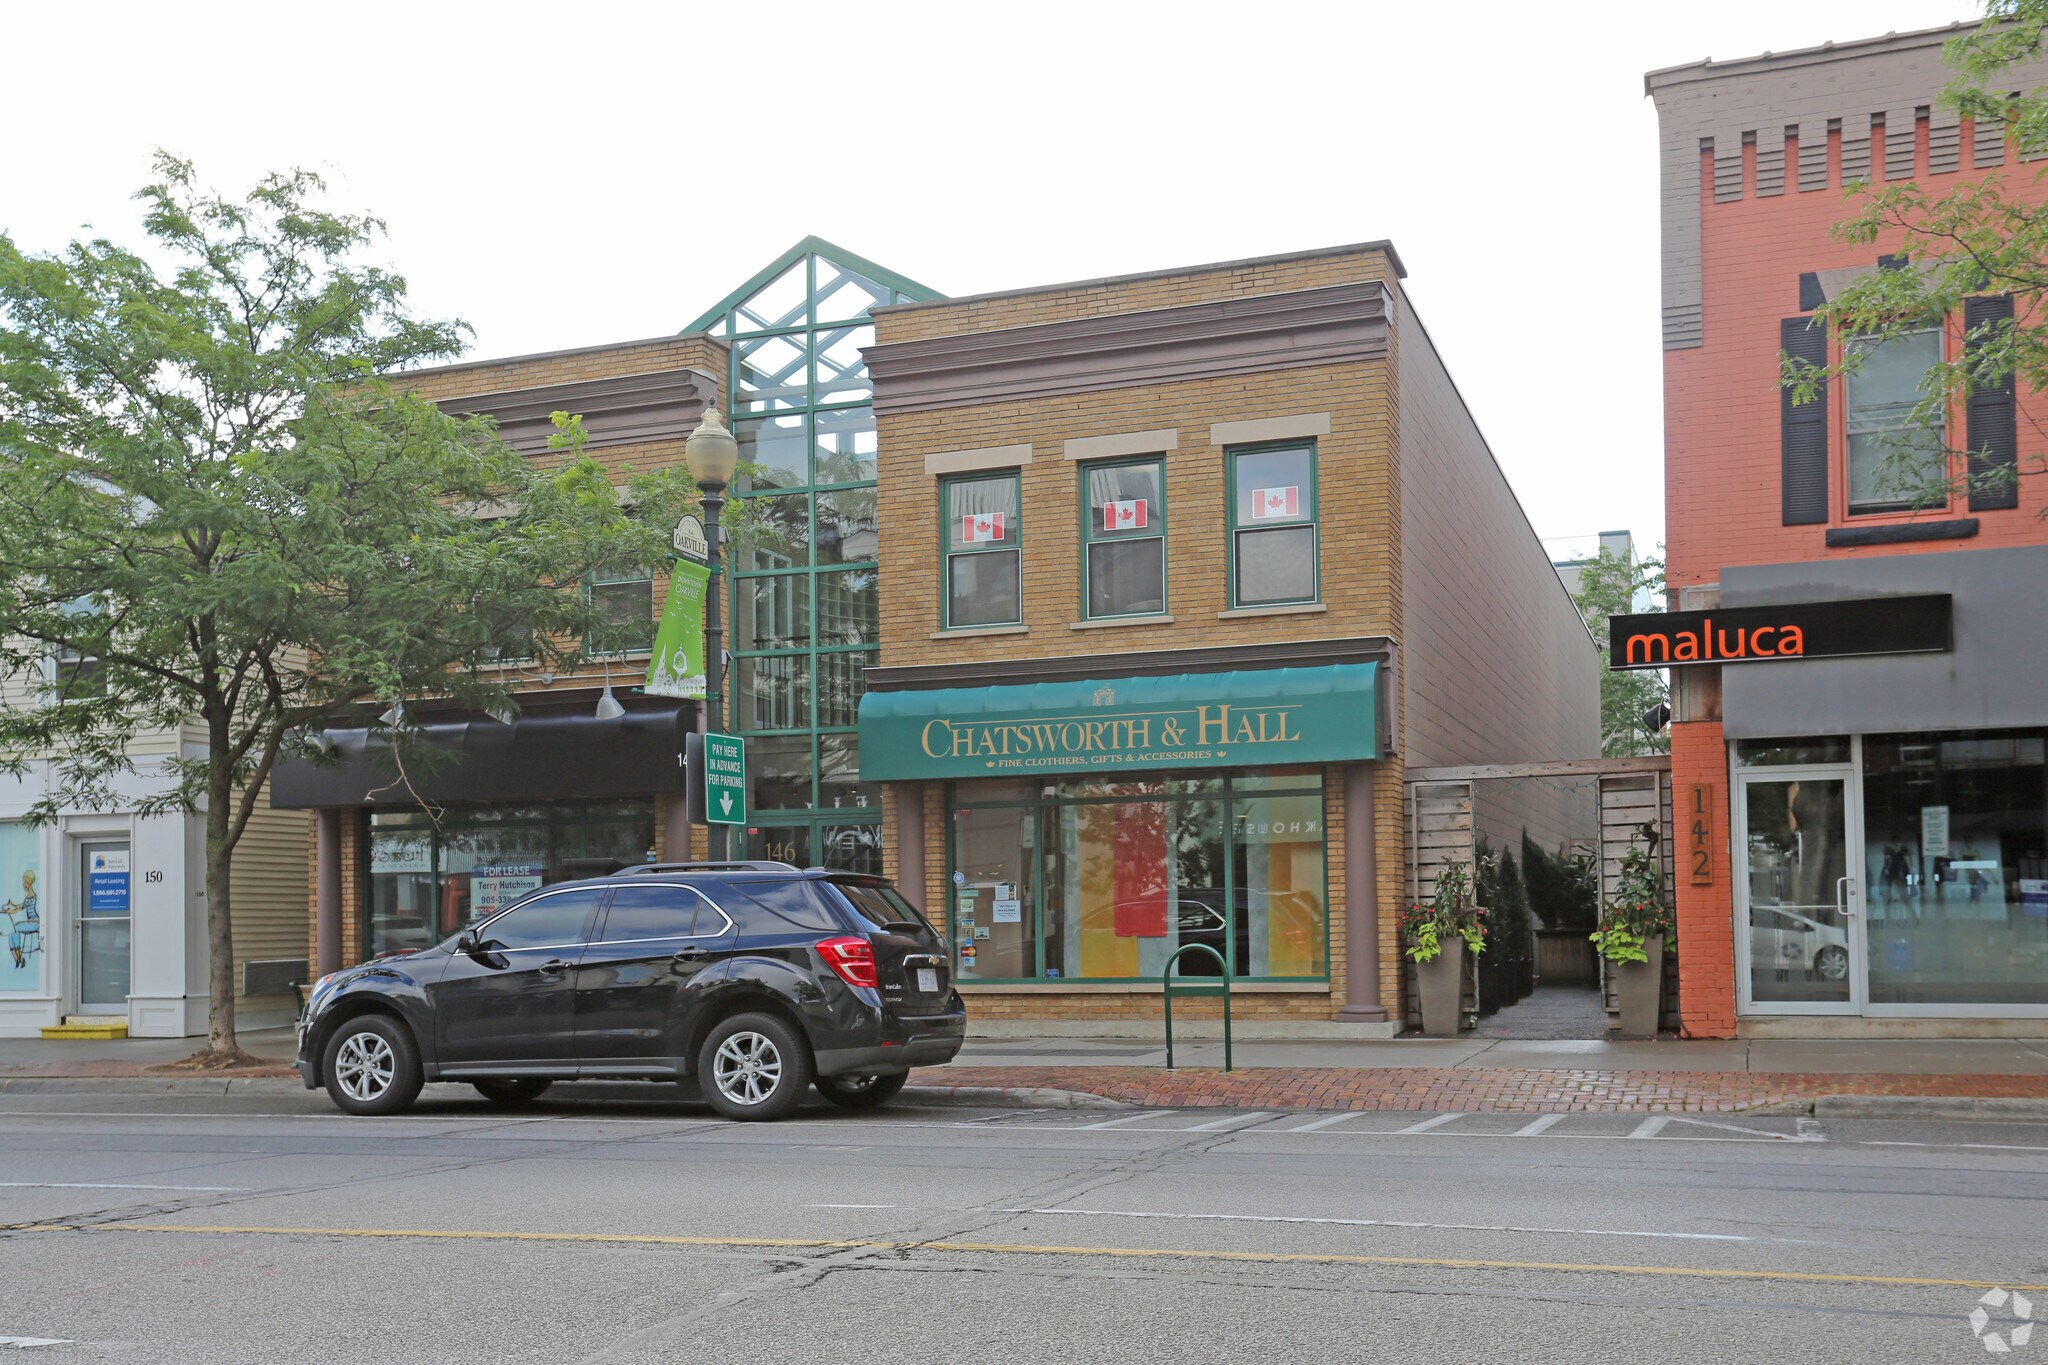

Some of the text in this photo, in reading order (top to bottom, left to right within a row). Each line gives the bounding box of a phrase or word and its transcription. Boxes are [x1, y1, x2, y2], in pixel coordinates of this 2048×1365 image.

[676, 533, 707, 555] OAKVILLE
[678, 575, 702, 588] DOWNTOWN
[675, 583, 700, 599] OAKVILLE
[1626, 618, 1804, 664] maluca
[1160, 716, 1187, 747] &
[1195, 704, 1301, 745] HALL
[712, 744, 737, 758] PAY HERE
[998, 750, 1212, 768] FINE CLOTHIERS, GIFTS & ACCESSORIES
[677, 752, 688, 768] 14
[709, 758, 741, 773] IN ADVANCE
[708, 773, 743, 788] FOR PARKING
[1691, 787, 1710, 876] 142
[764, 841, 796, 861] 146
[145, 870, 163, 883] 150
[483, 865, 530, 877] FOR LEASE
[478, 881, 536, 891] Terry Hutchison
